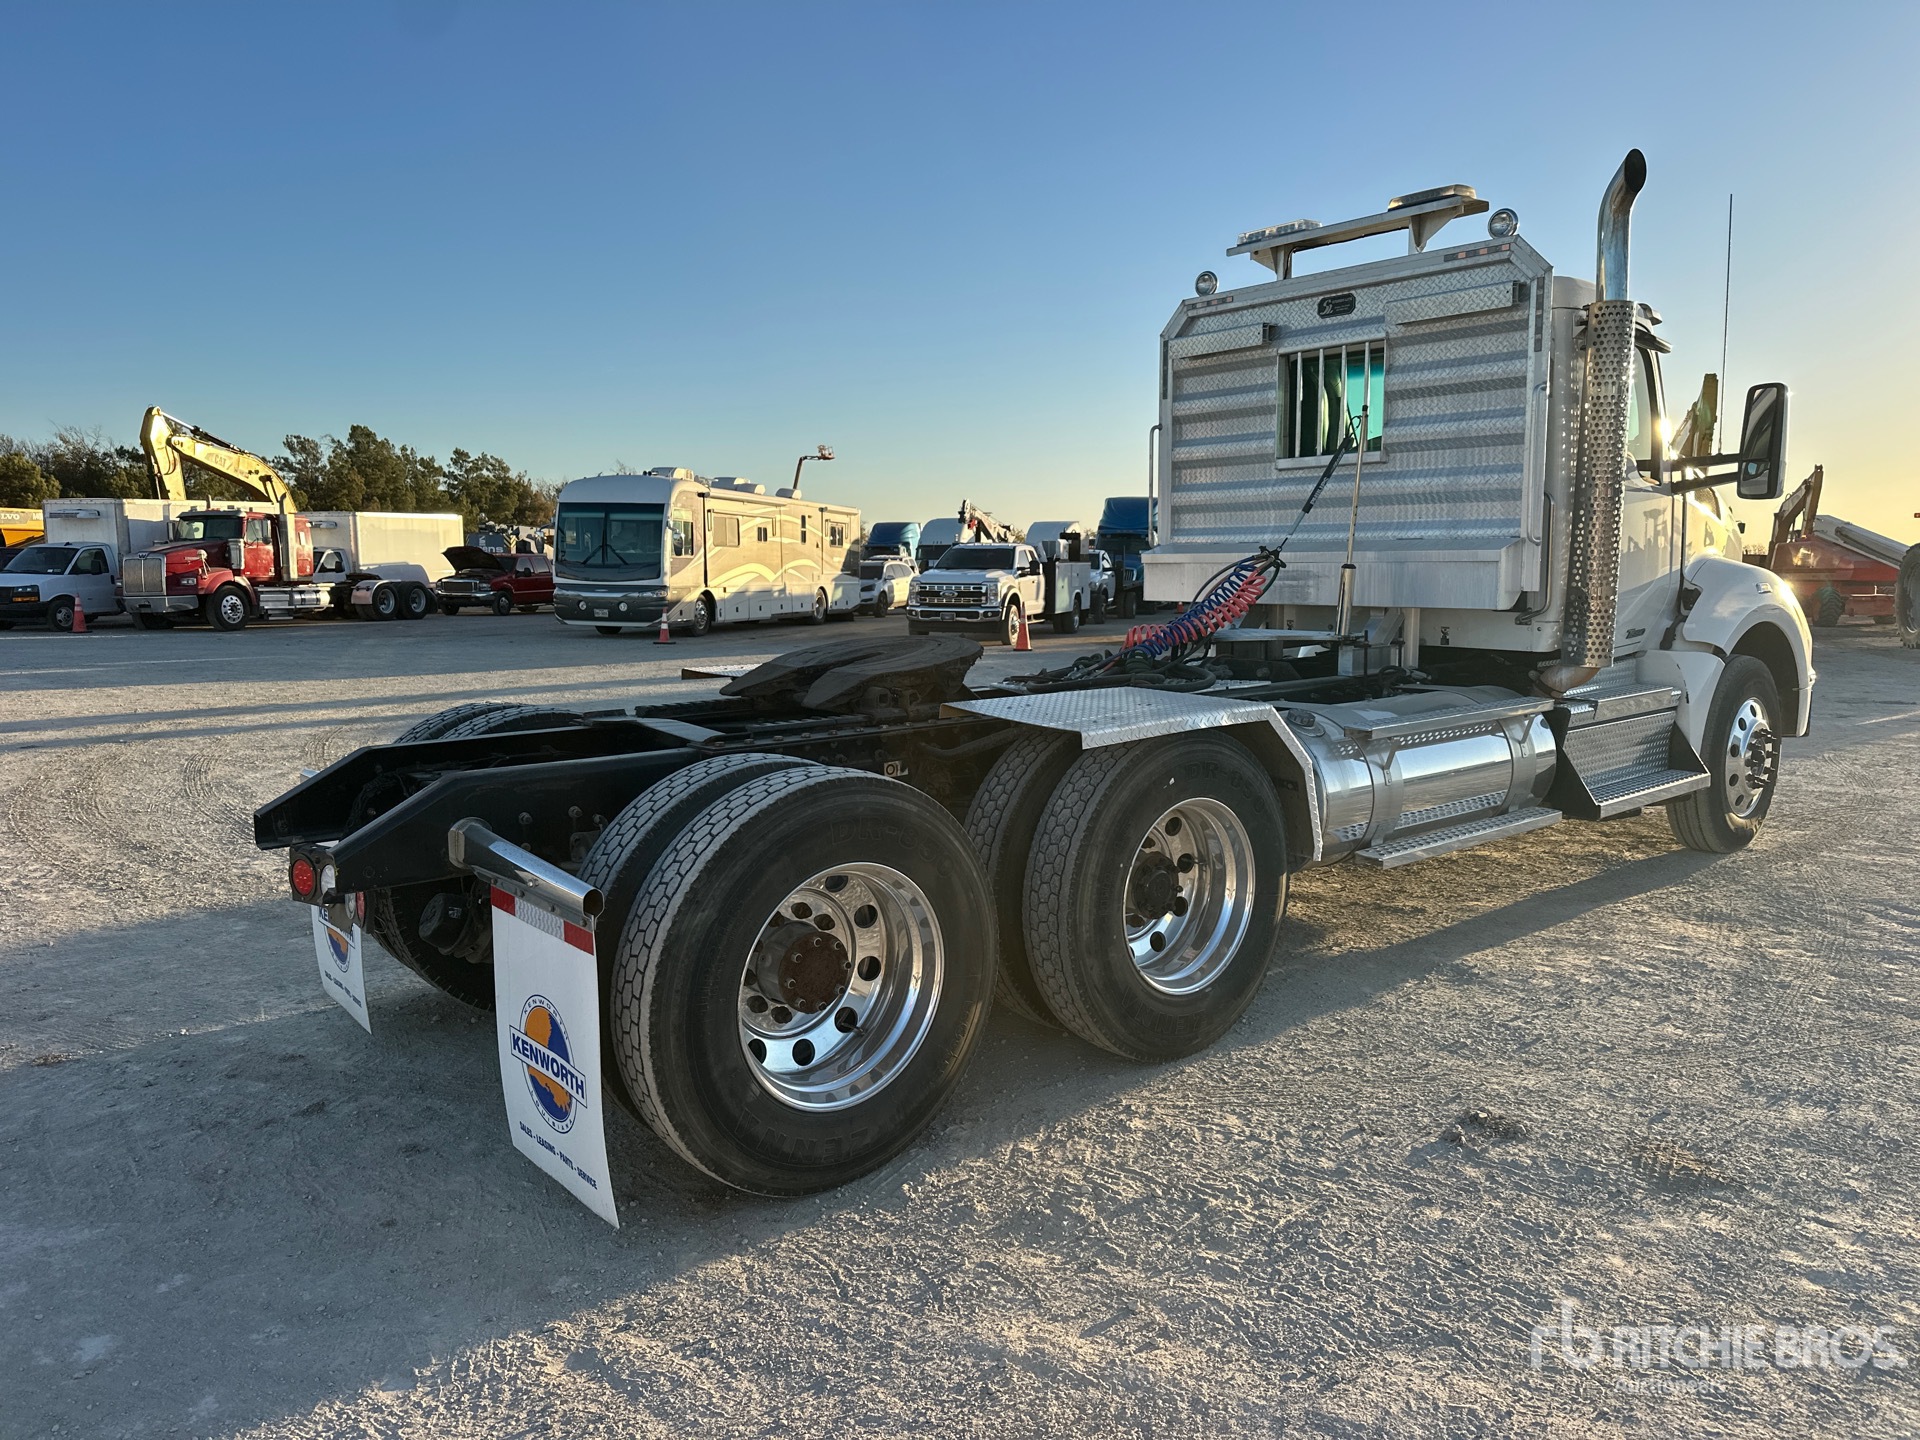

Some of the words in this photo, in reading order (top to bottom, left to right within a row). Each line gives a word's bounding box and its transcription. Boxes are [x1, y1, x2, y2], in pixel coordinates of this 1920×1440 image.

[512, 1032, 585, 1100] KENWORTH
[519, 1120, 533, 1139] SALES
[535, 1134, 557, 1156] LEASING
[559, 1150, 573, 1171] PARTS
[576, 1166, 598, 1190] SERVICE
